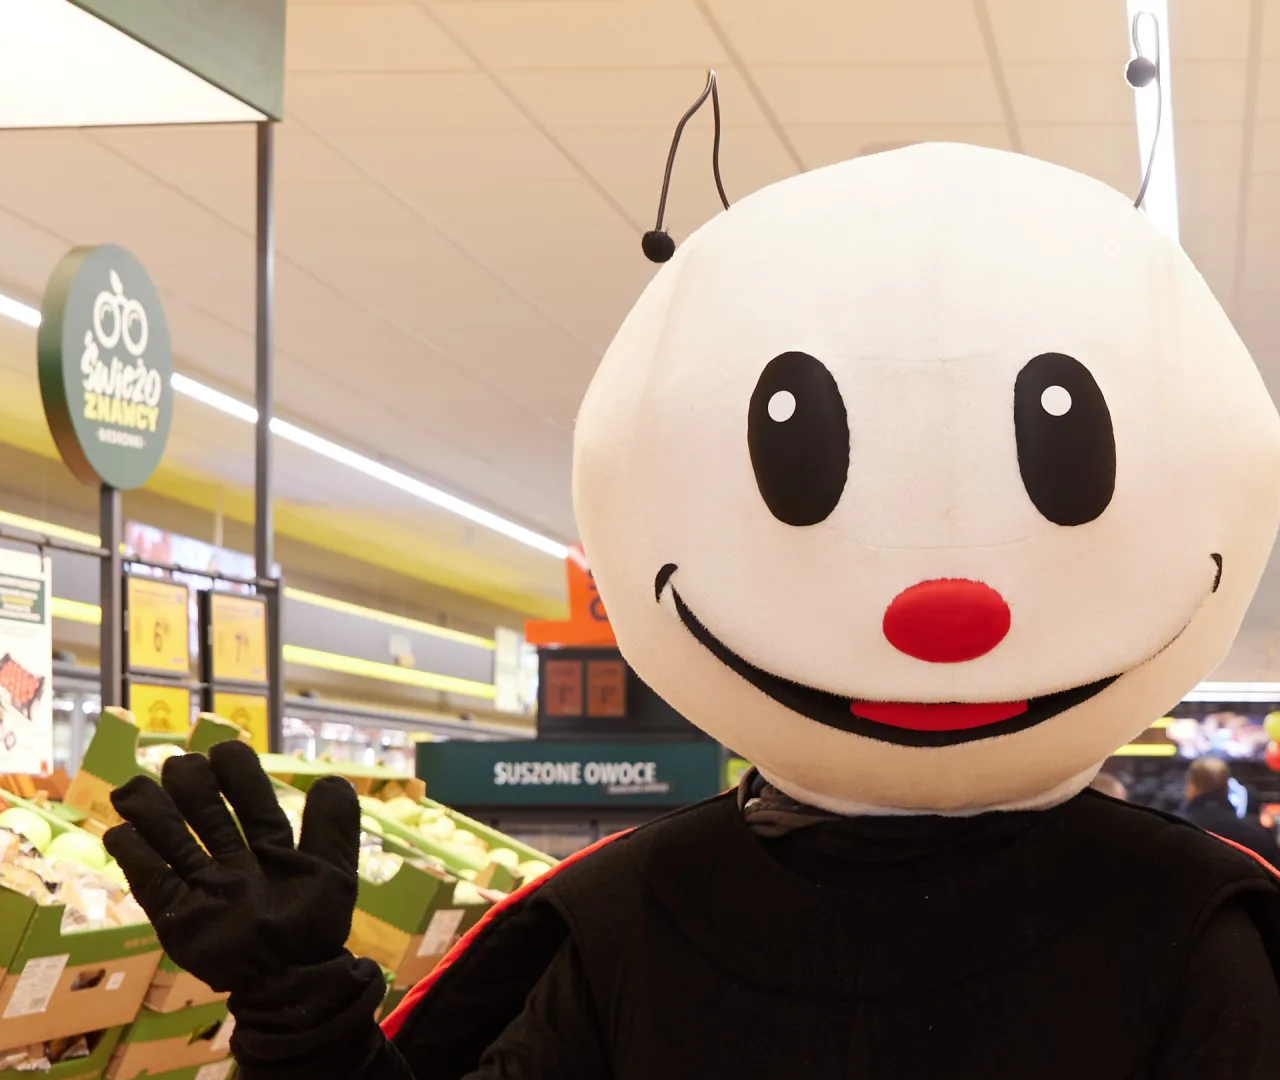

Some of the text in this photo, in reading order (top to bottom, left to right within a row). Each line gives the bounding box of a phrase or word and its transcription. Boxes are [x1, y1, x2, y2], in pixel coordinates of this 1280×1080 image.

[83, 392, 160, 433] ZNAWCY
[492, 761, 658, 787] SUSZONE OWOCE
